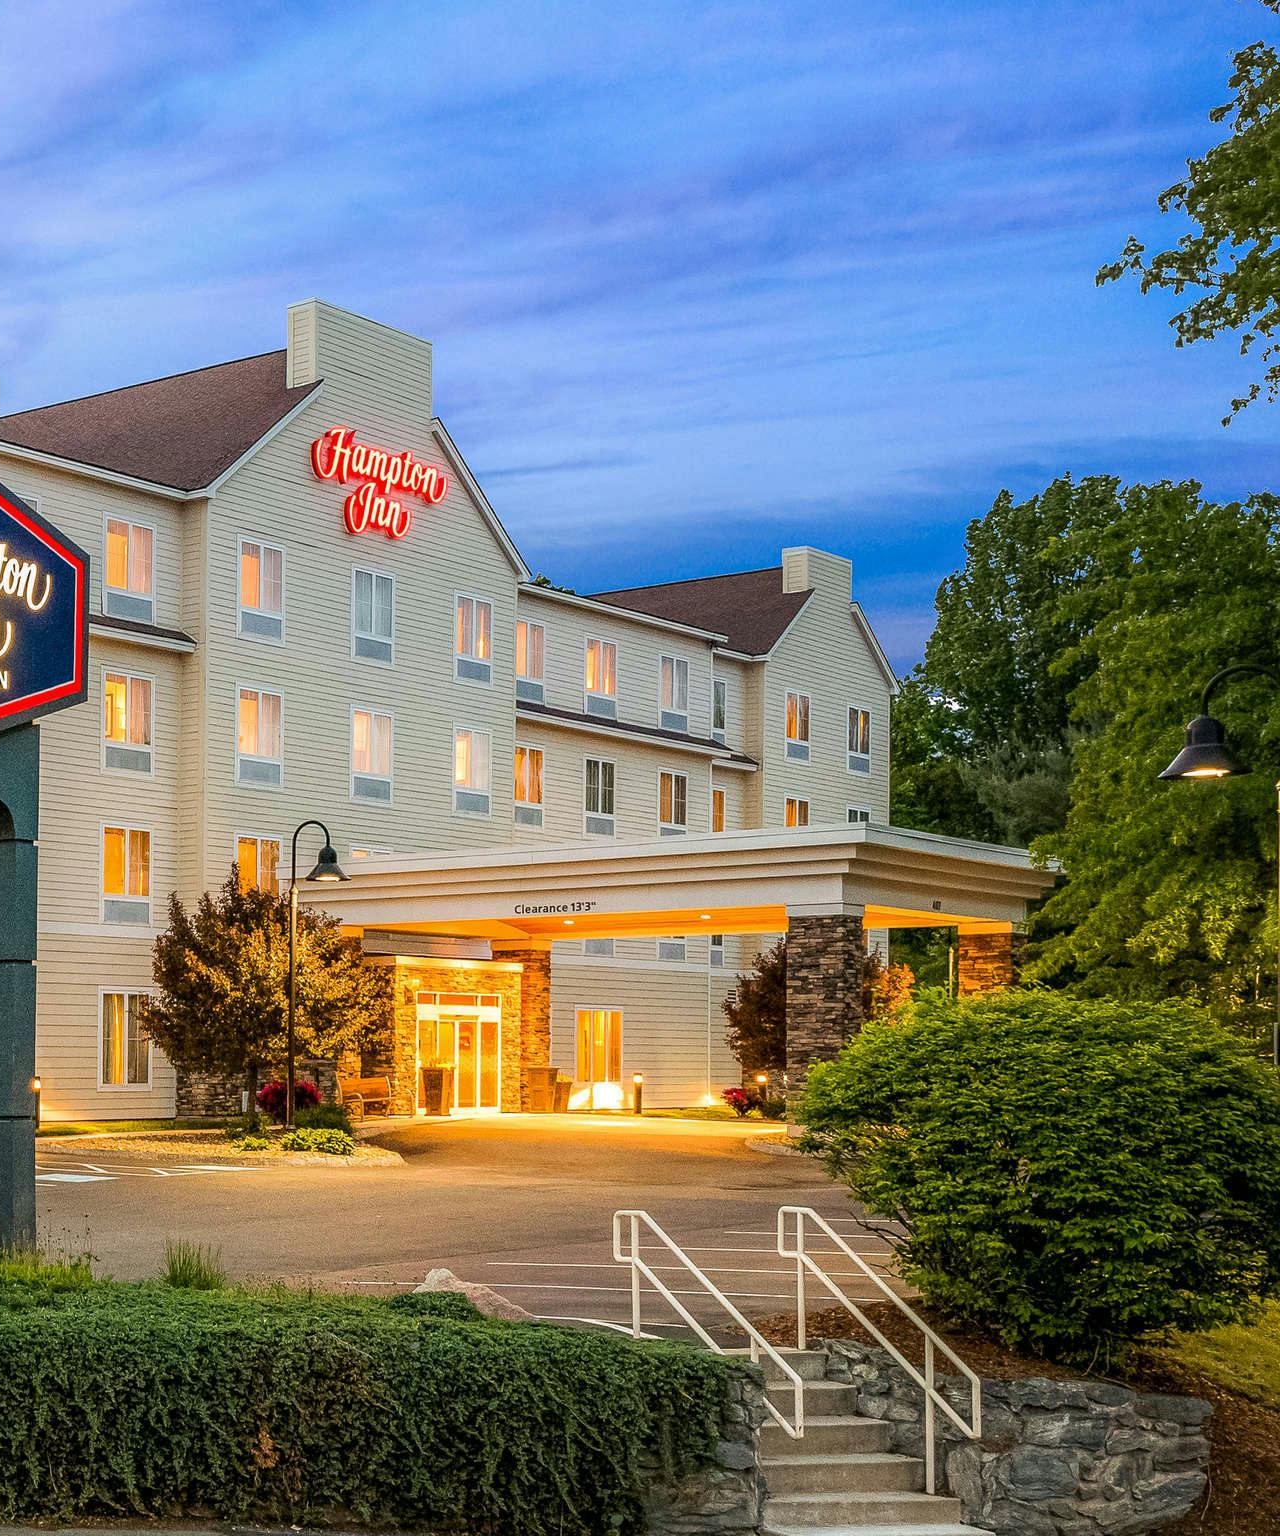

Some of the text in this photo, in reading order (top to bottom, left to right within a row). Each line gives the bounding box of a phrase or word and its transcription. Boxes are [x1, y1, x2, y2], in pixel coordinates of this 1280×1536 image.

[312, 426, 448, 504] Hampton
[344, 481, 412, 539] Inn
[514, 904, 568, 915] Clearance
